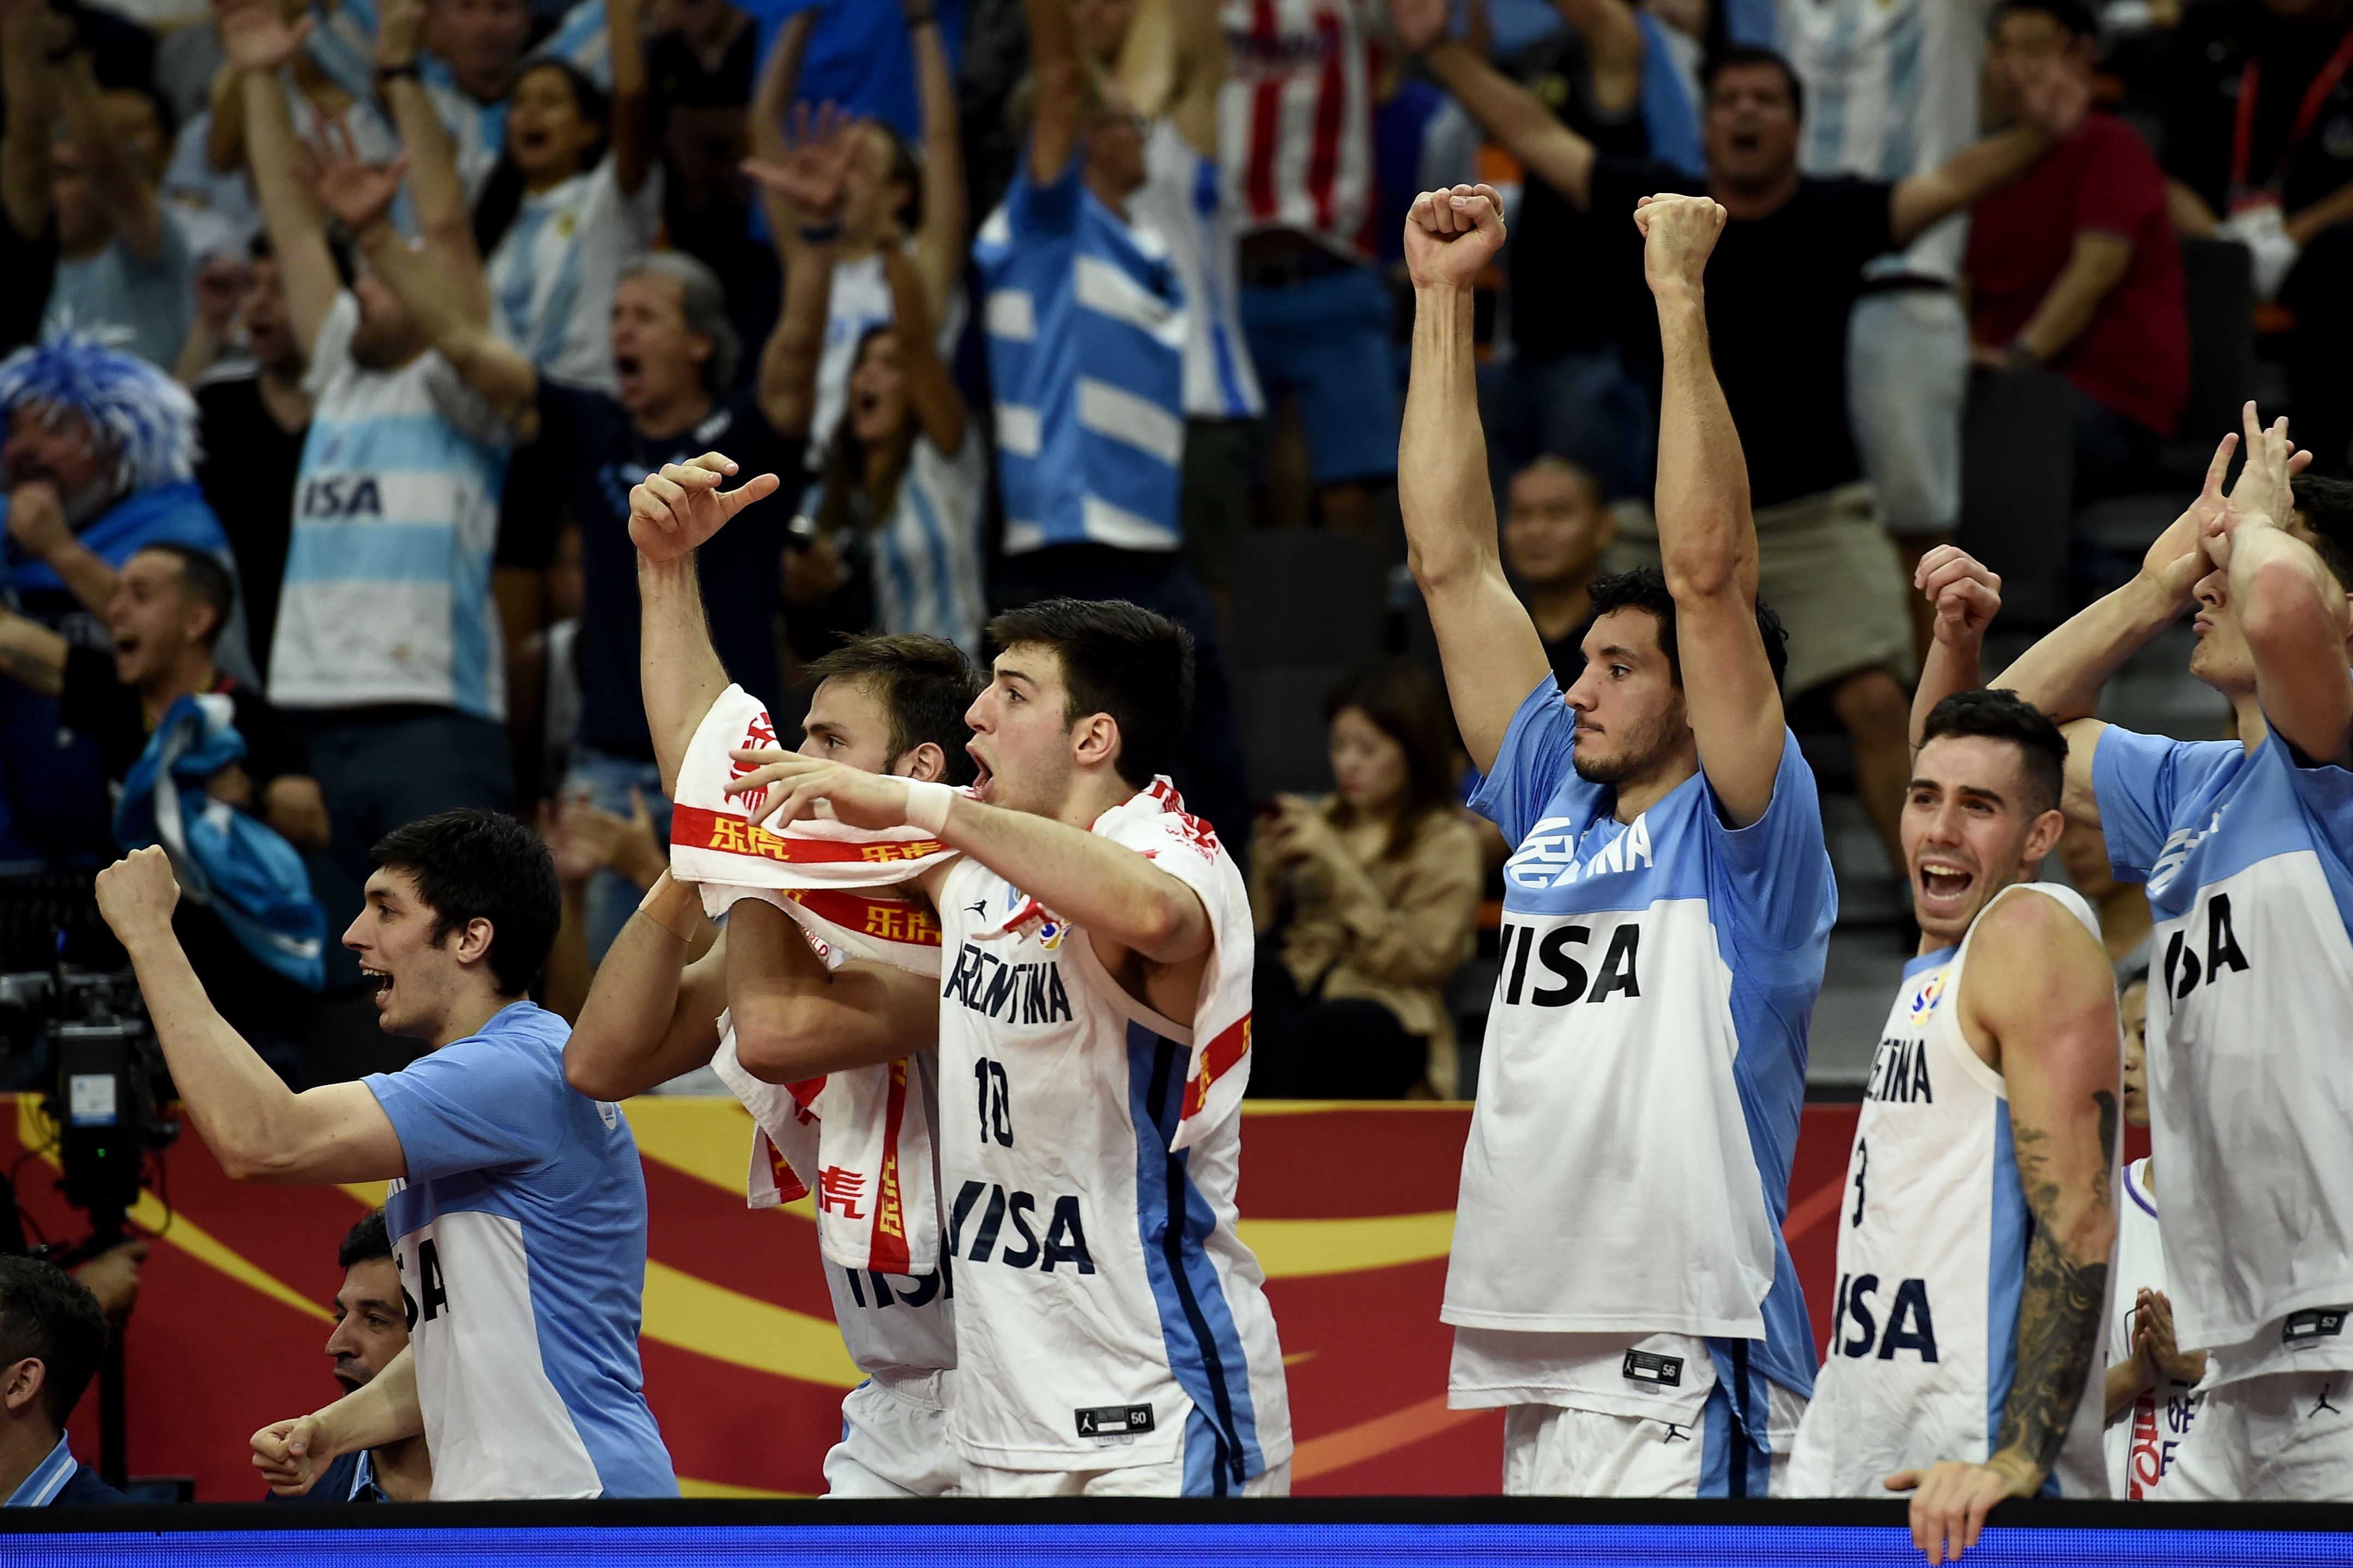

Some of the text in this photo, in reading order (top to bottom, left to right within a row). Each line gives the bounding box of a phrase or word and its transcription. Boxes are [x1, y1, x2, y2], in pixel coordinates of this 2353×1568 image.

[708, 816, 791, 860] 乐虎
[974, 1056, 1015, 1148] 10
[1131, 1411, 1146, 1425] 50
